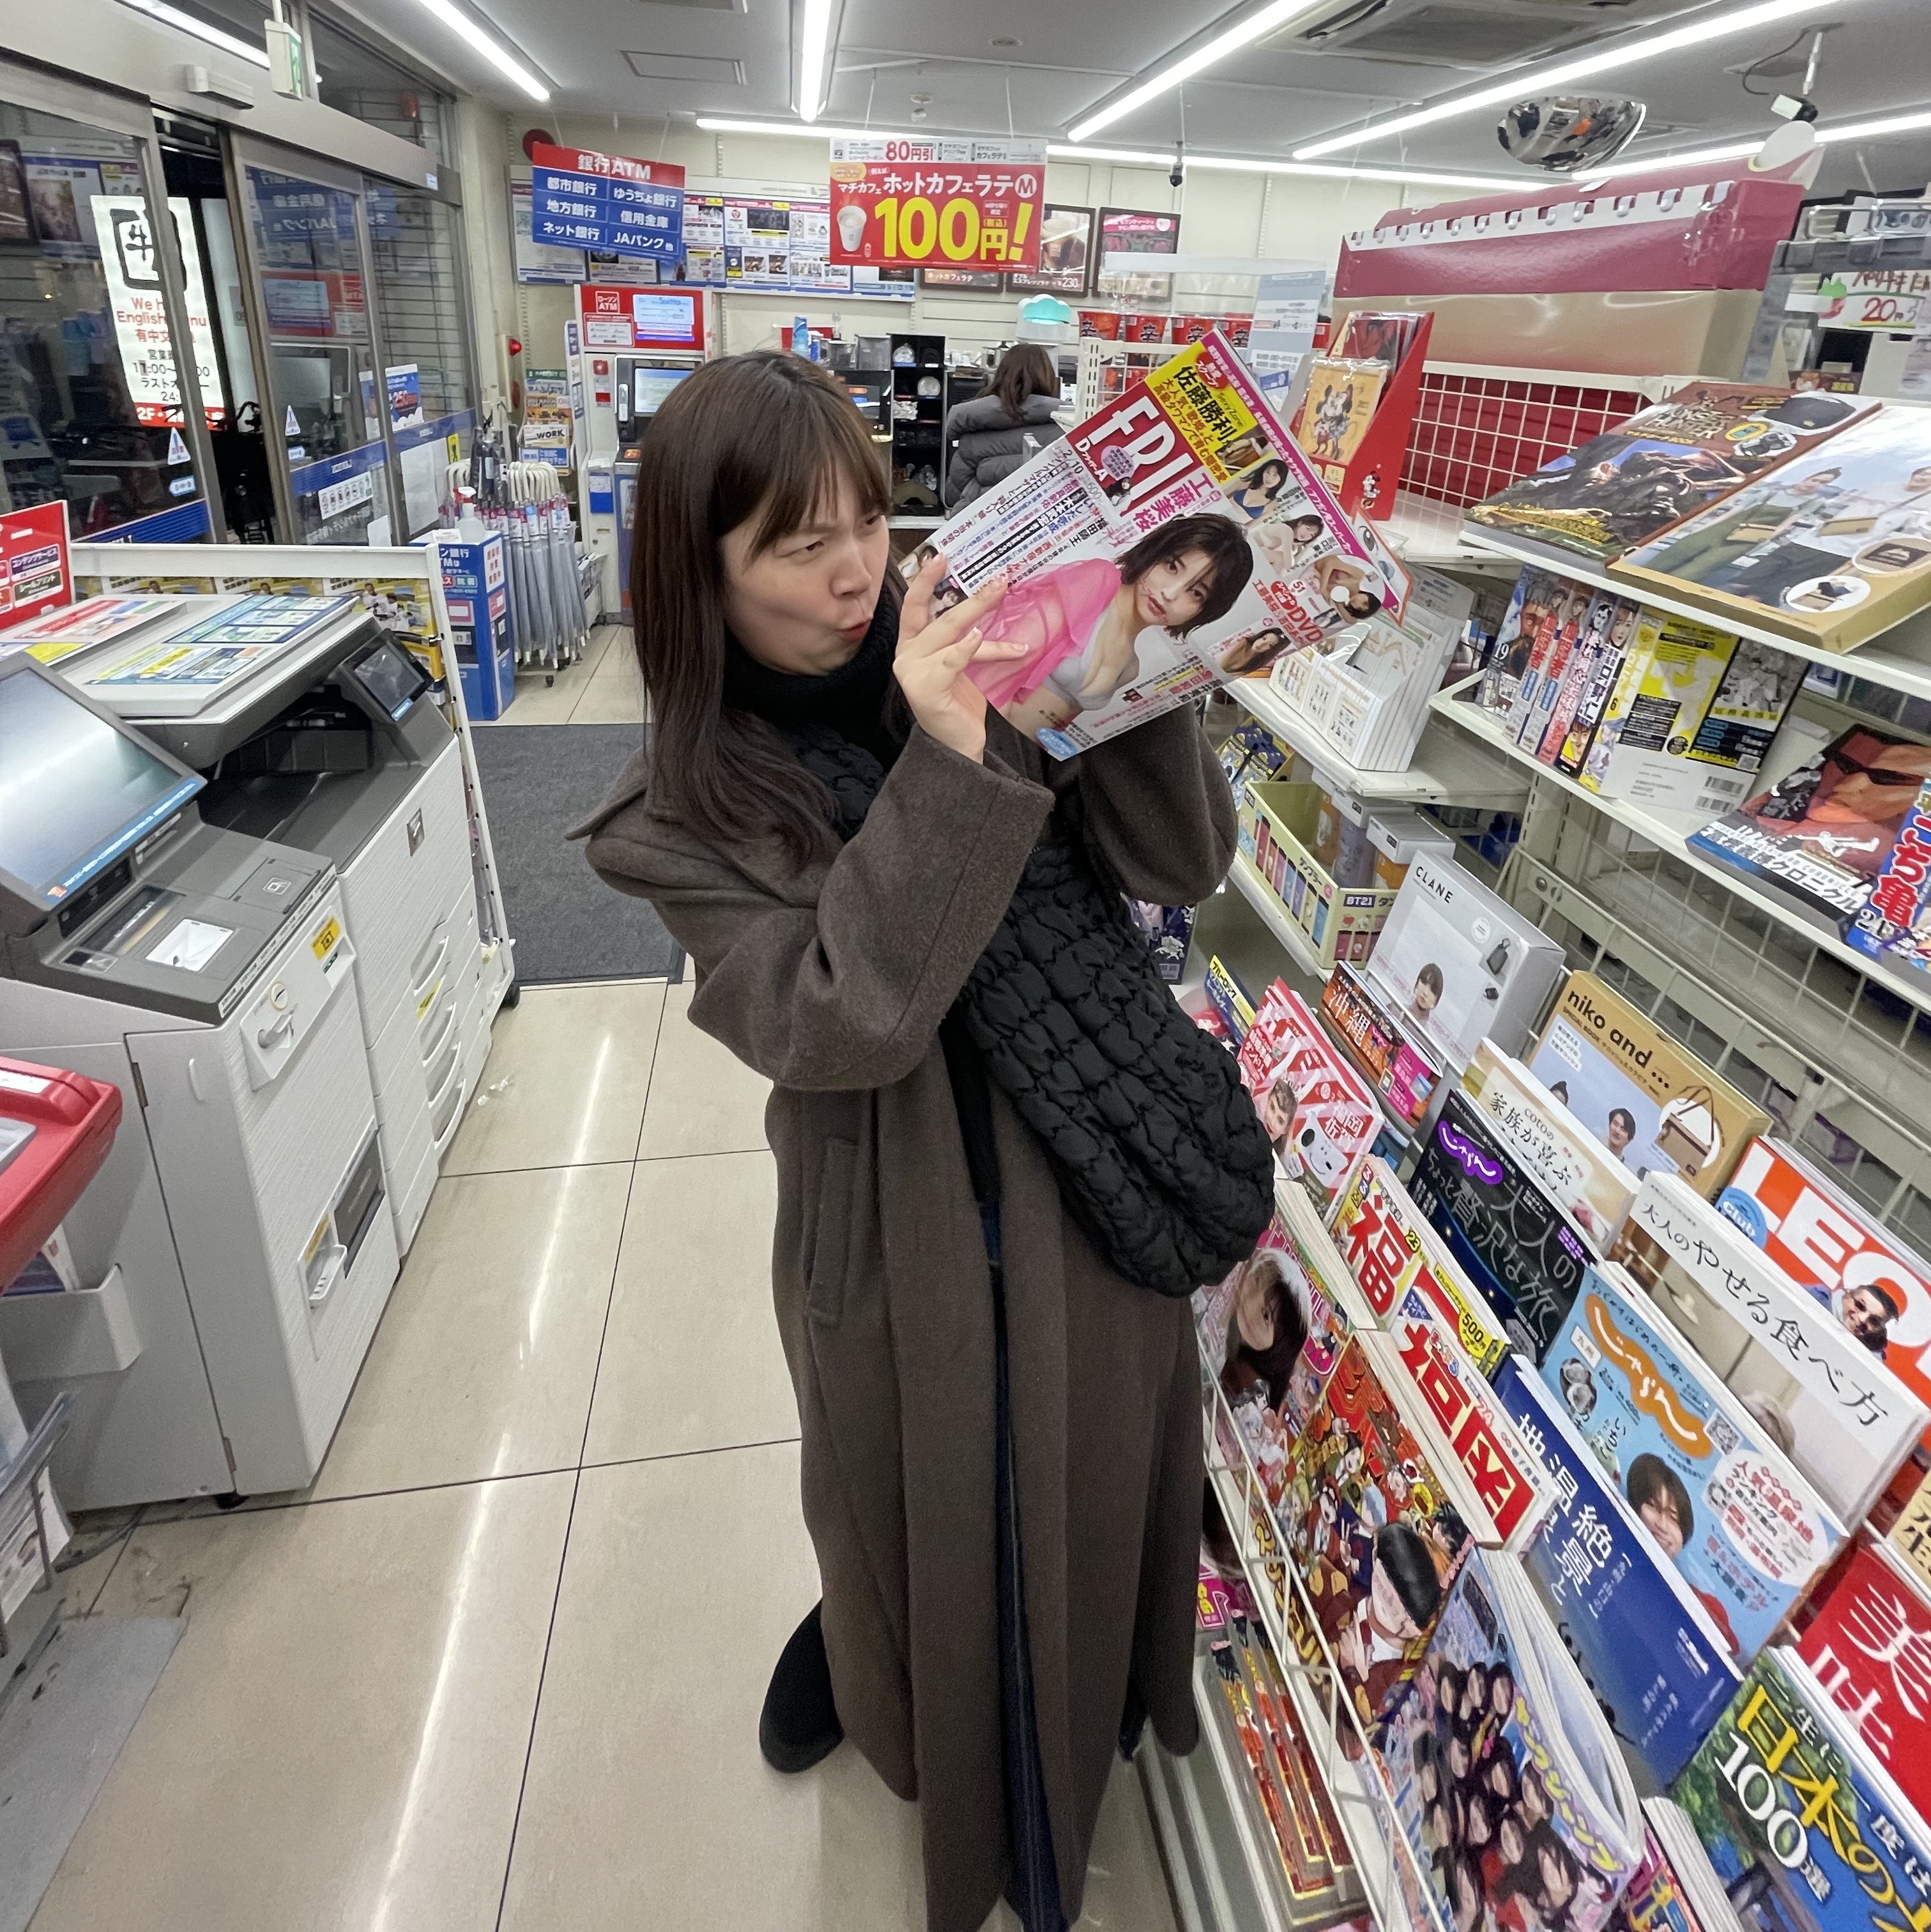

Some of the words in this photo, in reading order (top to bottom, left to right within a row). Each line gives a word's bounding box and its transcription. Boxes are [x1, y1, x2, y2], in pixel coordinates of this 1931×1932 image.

[886, 141, 933, 161] 80円引
[577, 153, 651, 180] 銀行ATM
[546, 177, 597, 196] 都市銀行
[613, 187, 677, 208] ゆうちょ銀行
[546, 199, 597, 217] 地方銀行
[620, 210, 669, 229] 信用金庫
[543, 221, 600, 241] ネット銀行
[116, 310, 167, 326] English
[132, 297, 153, 310] We
[599, 302, 618, 312] ATM
[1140, 325, 1158, 343] 辛
[1194, 360, 1219, 390] スクープ
[1172, 362, 1238, 444] 佐藤勝利
[537, 429, 565, 439] WORK
[1061, 448, 1085, 475] 2/10
[1085, 480, 1103, 500] 600
[1131, 472, 1214, 534] 工藤美桜
[1286, 606, 1324, 645] DVD
[1495, 643, 1509, 660] 19
[1610, 698, 1619, 710] 6
[1415, 865, 1453, 905] CLANE
[1345, 895, 1374, 907] BT21
[1324, 985, 1375, 1048] 沖縄
[1564, 986, 1609, 1032] niko
[1607, 1022, 1655, 1069] and
[1488, 1089, 1576, 1188] 家族が喜ぶ
[1722, 1200, 1757, 1238] Club
[1404, 1229, 1423, 1254] 23
[1424, 1146, 1566, 1341] ちょっと贅沢な旅
[1490, 1181, 1577, 1290] 大人の
[1345, 1192, 1418, 1319] 福
[1729, 1142, 1930, 1365] LEO
[1641, 1203, 1889, 1426] 大人のやせる食べ方
[1548, 1502, 1617, 1606] 絶景と
[1737, 1685, 1931, 1932] 日本の
